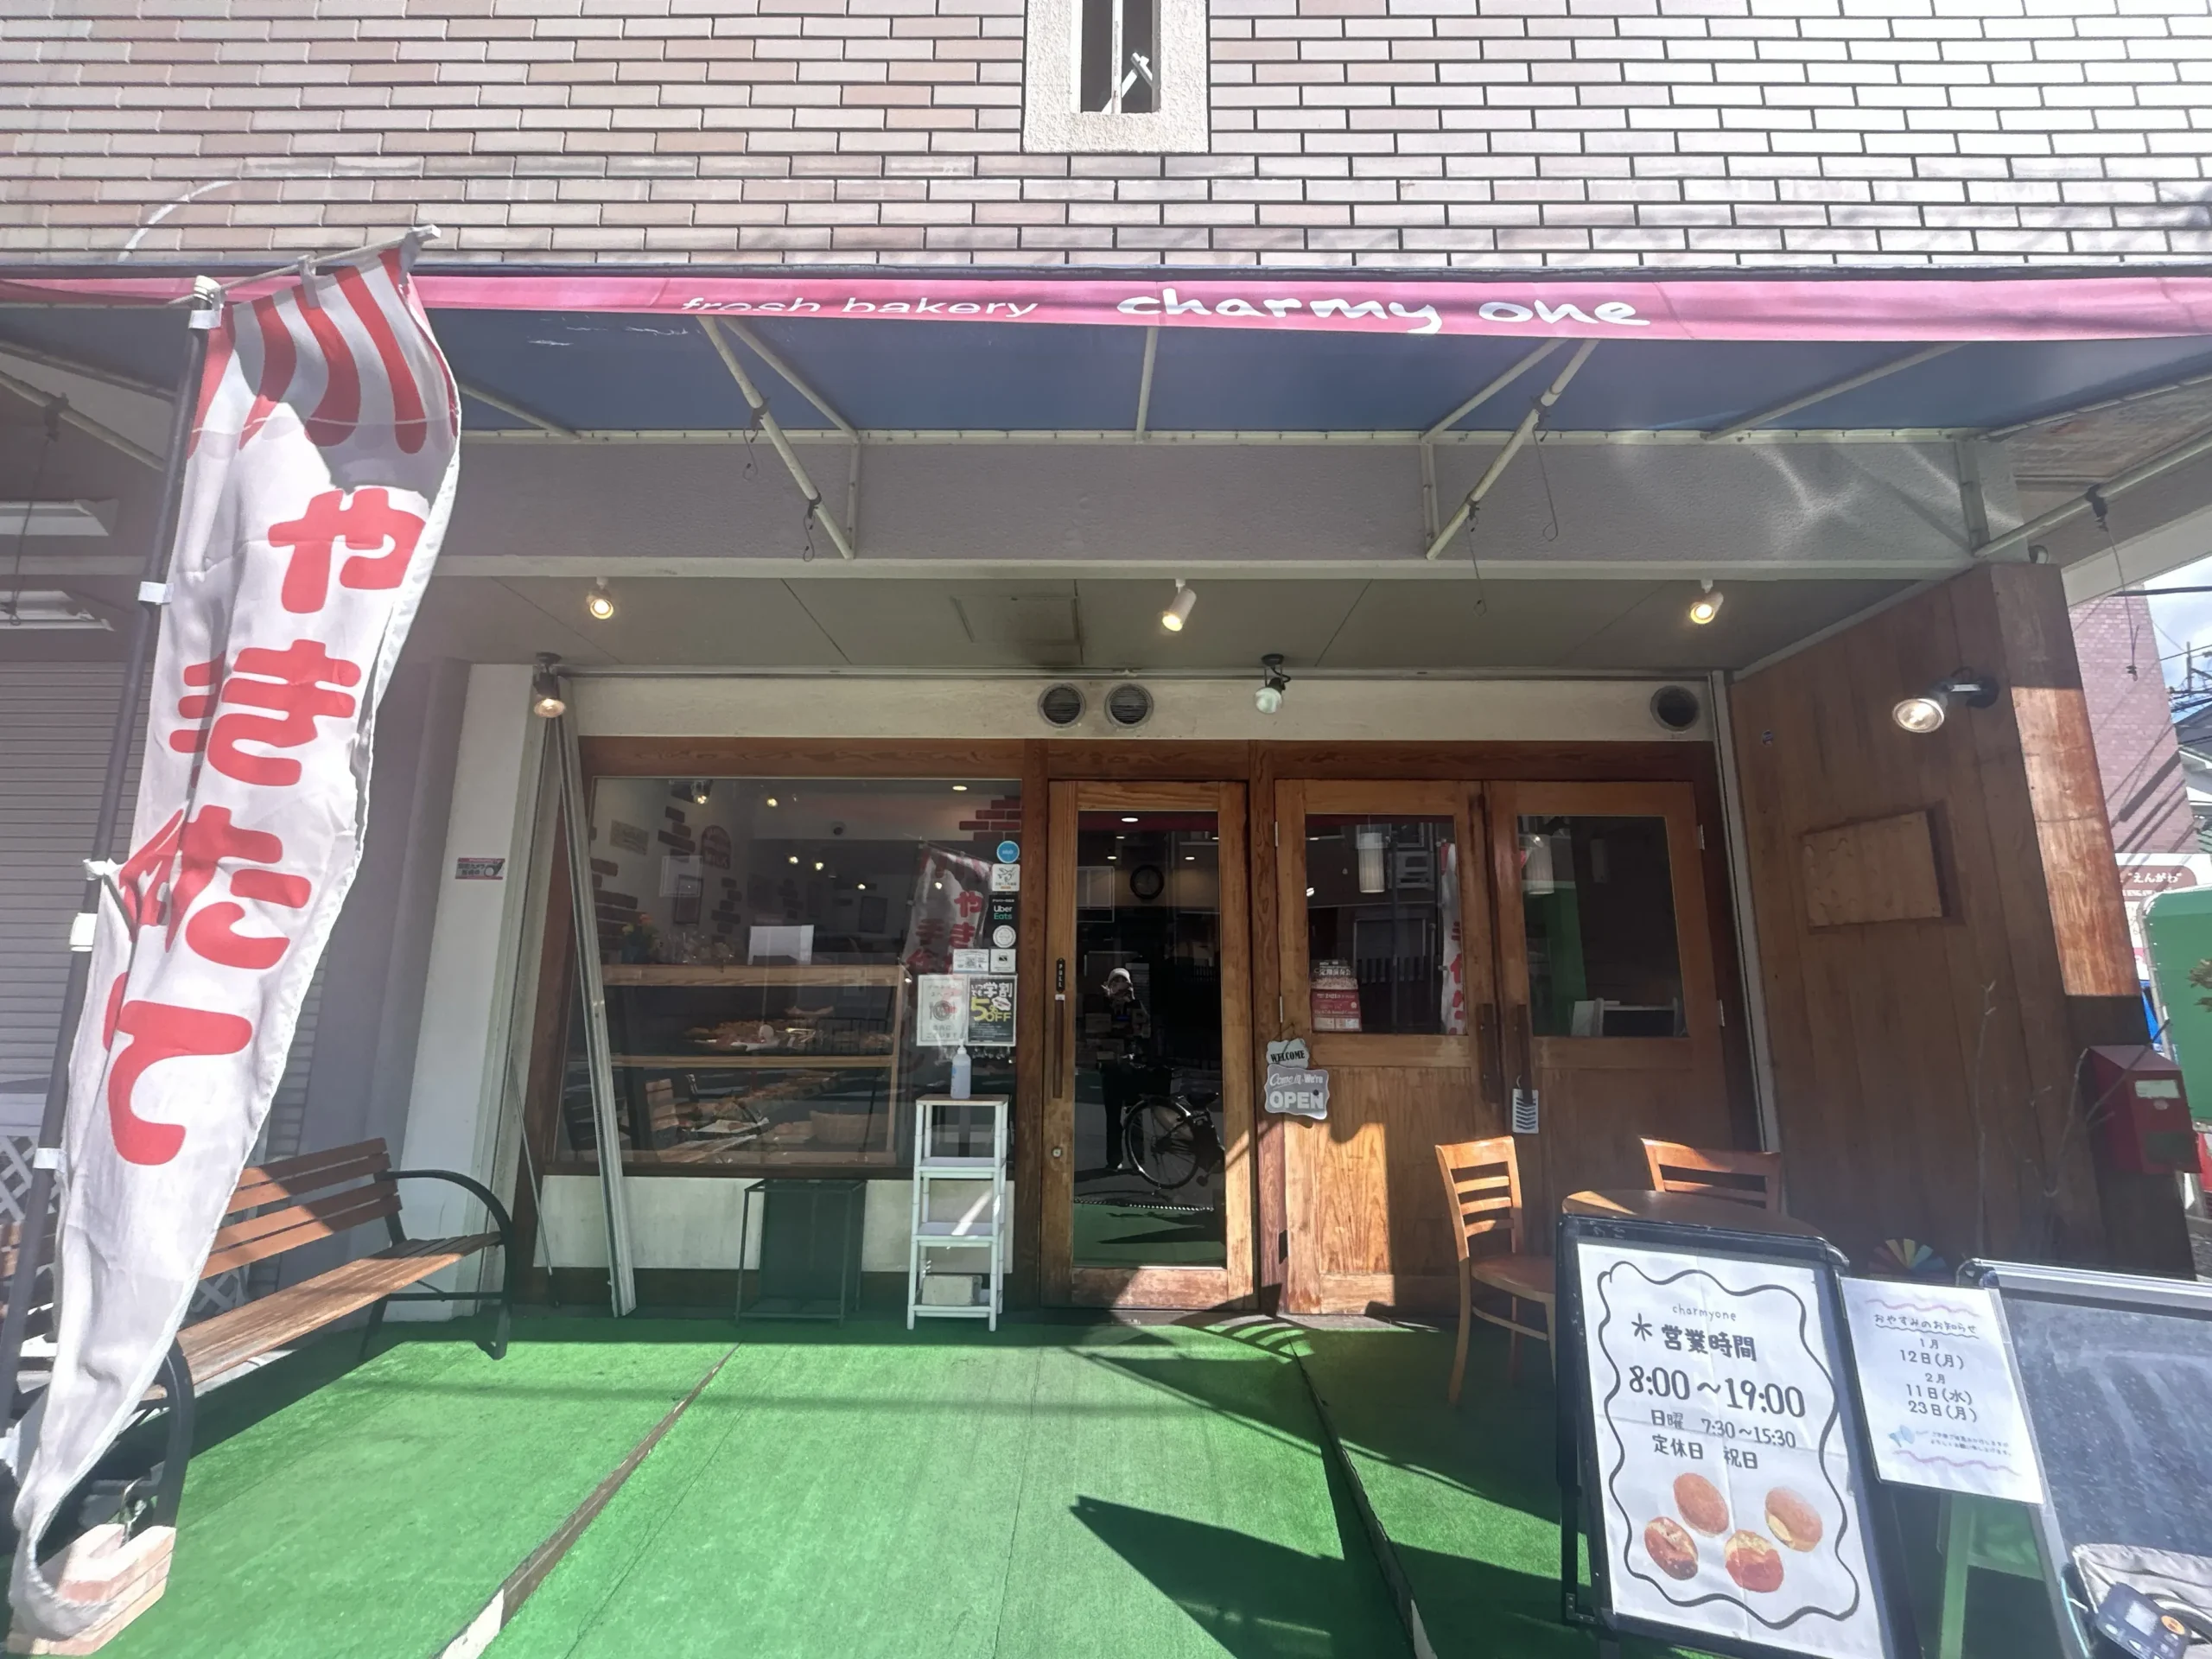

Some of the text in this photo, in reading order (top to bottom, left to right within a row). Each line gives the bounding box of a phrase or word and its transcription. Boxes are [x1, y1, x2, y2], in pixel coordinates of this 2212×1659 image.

[842, 296, 1039, 317] bakery
[1116, 288, 1650, 334] charmy one
[106, 486, 429, 1167] やきたて
[983, 982, 1013, 997] 学割
[985, 1012, 1012, 1022] OFF
[1270, 1050, 1306, 1063] WELCOME
[1269, 1072, 1294, 1086] Come
[1304, 1073, 1324, 1084] We're
[1269, 1090, 1324, 1109] OPEN
[1672, 1303, 1737, 1323] charmyone
[1873, 1313, 1977, 1334] おやすみのお知らせ
[1661, 1323, 1758, 1363] 営業時間
[1919, 1338, 1939, 1350] 1月
[1899, 1349, 1964, 1370] 12日(月)
[1924, 1372, 1946, 1384] 2月
[1906, 1383, 1973, 1405] 11日(水)
[1650, 1408, 1685, 1431] 日曜
[1908, 1400, 1978, 1423] 23日(月)
[1652, 1433, 1759, 1470] 定休日 祝日
